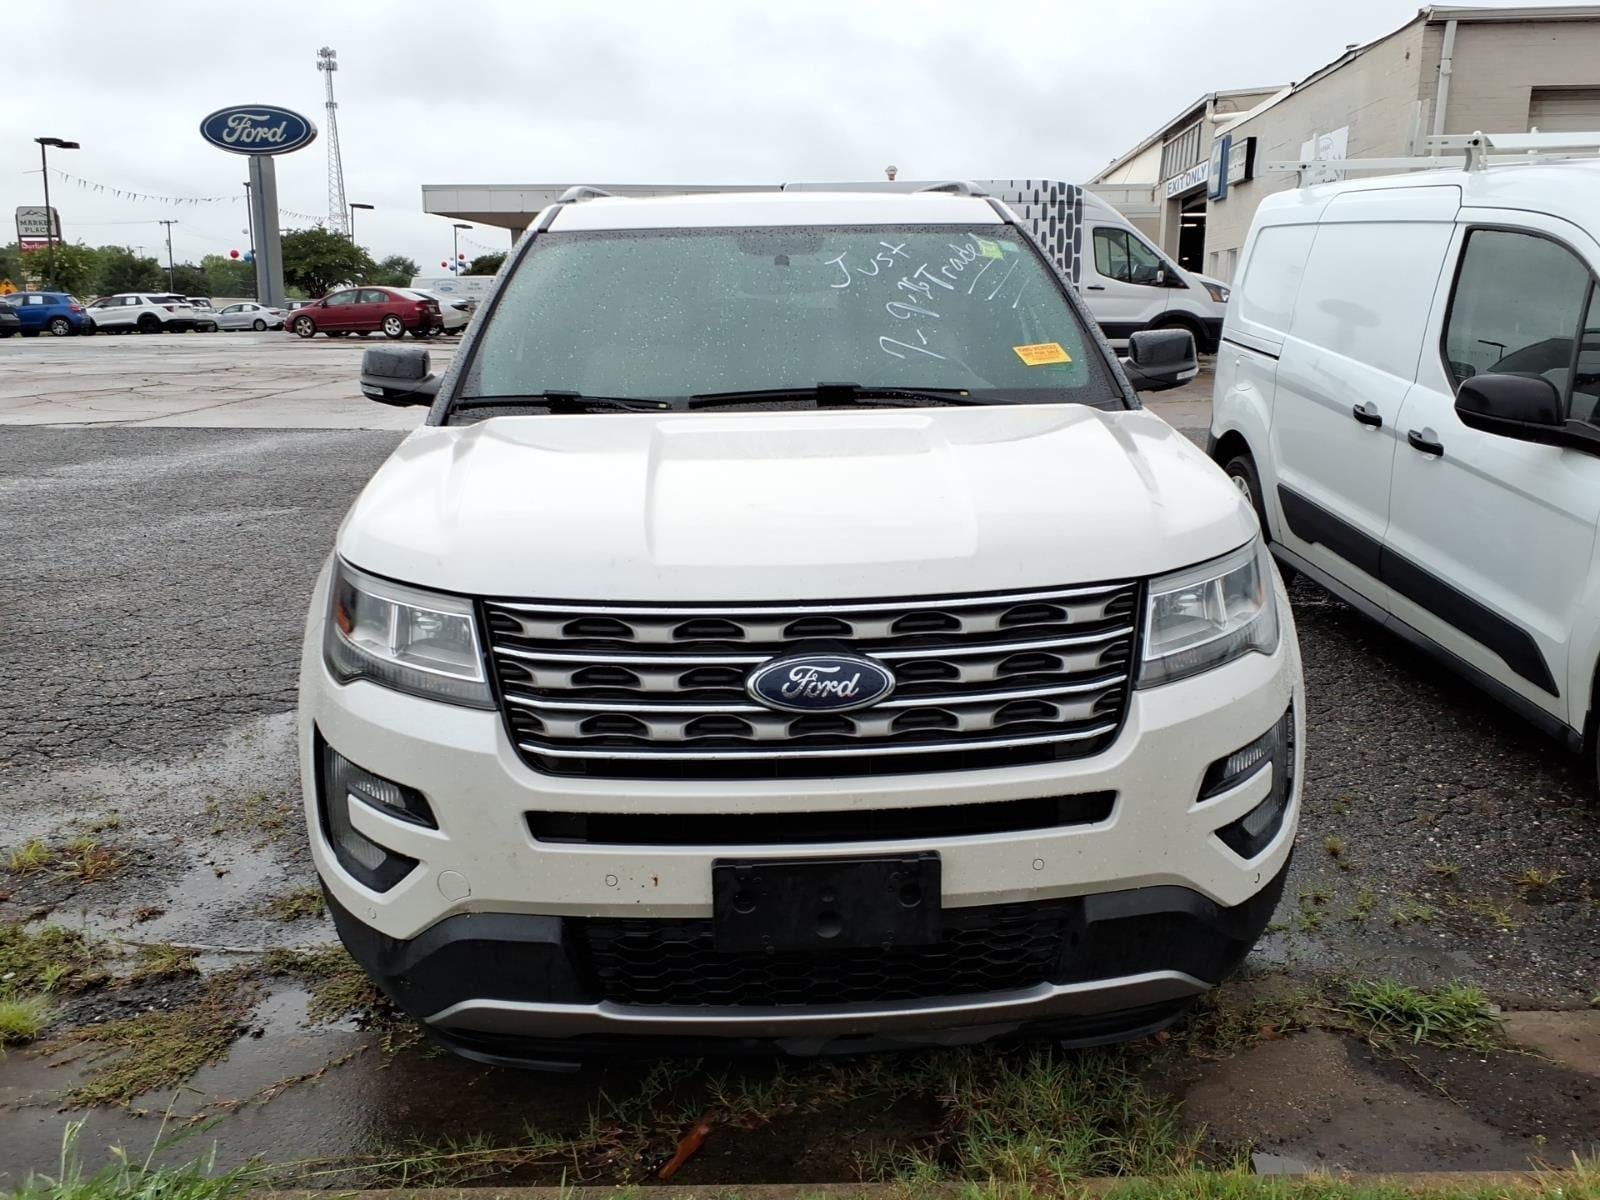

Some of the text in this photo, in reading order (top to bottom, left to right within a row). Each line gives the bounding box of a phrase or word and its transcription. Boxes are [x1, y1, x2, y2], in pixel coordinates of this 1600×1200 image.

[222, 113, 288, 143] Ford
[1168, 175, 1185, 195] EXIT
[1185, 164, 1207, 186] ONLY
[824, 241, 910, 288] Just
[781, 665, 861, 699] Ford
